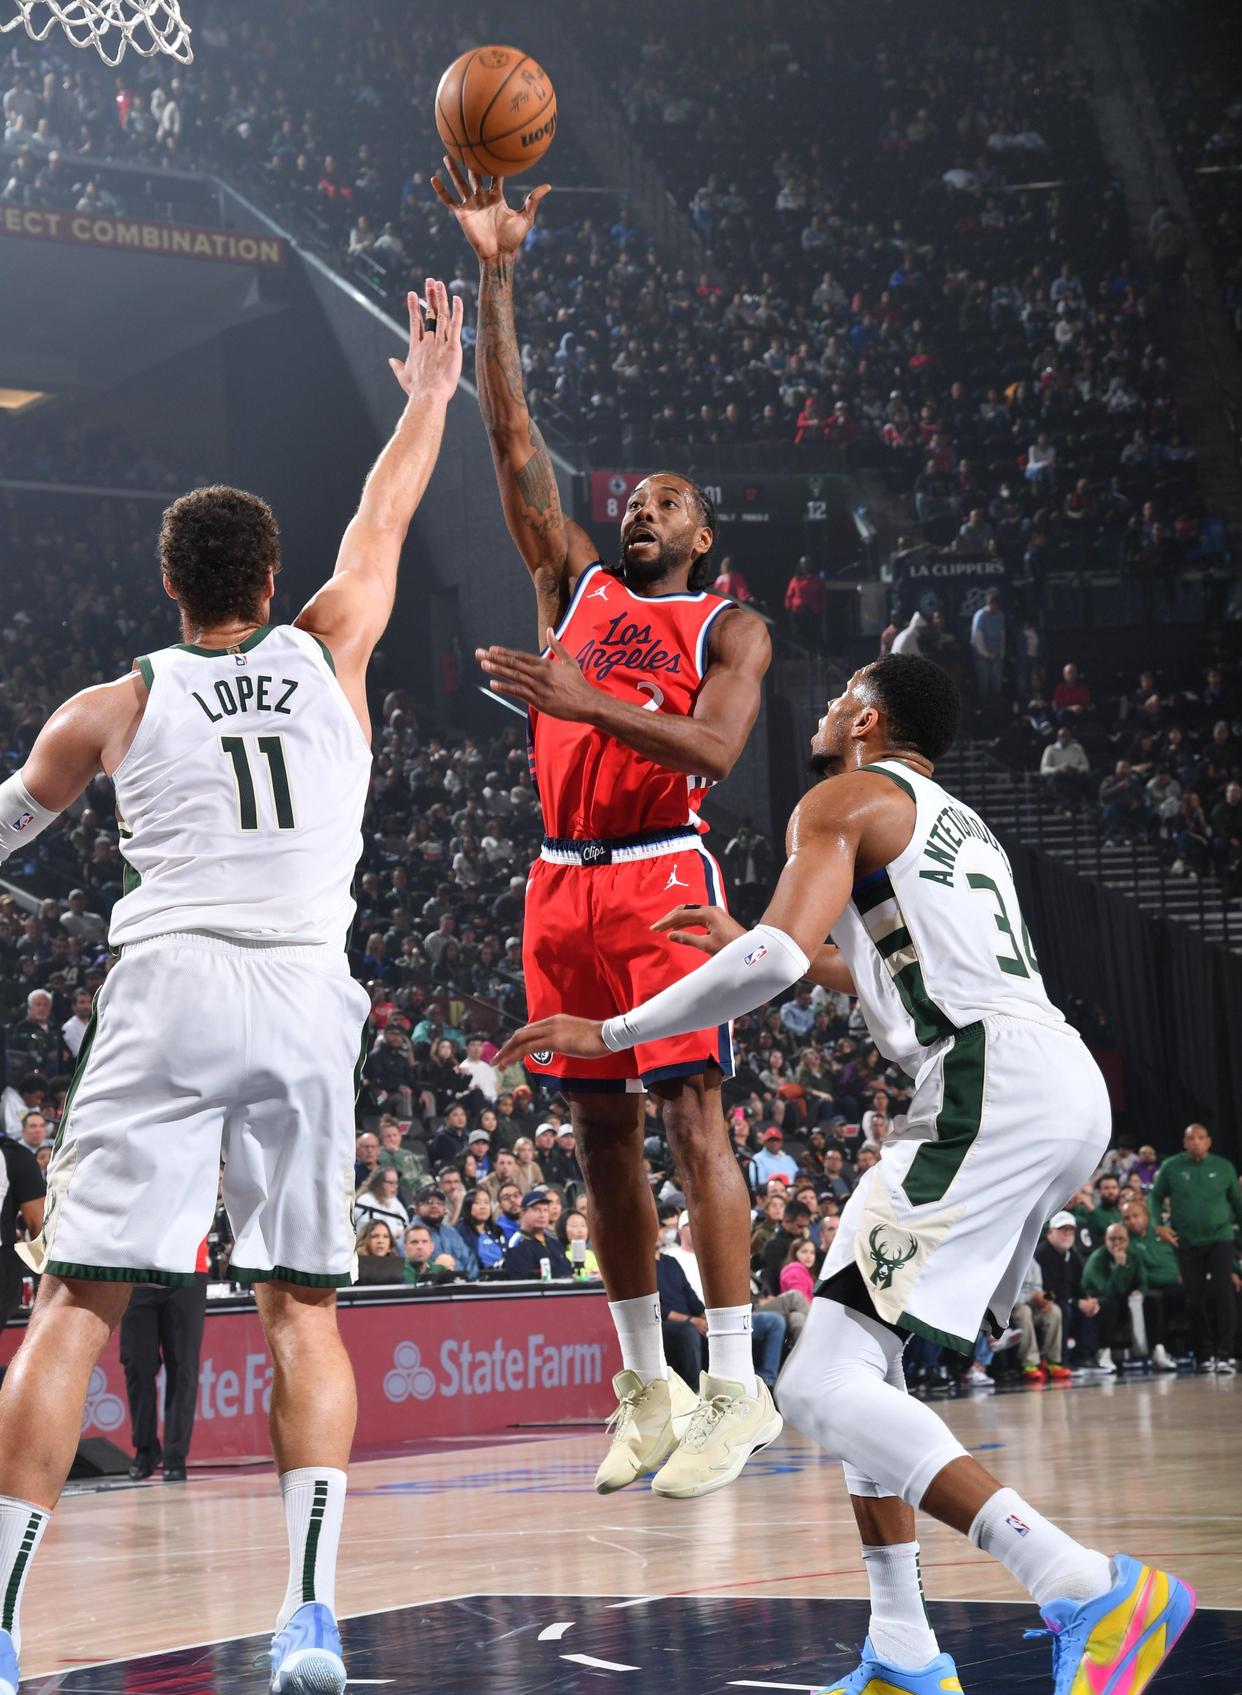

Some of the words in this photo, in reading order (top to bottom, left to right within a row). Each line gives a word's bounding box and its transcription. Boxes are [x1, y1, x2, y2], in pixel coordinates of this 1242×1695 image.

[0, 208, 60, 235] ECT
[72, 218, 280, 262] COMBINATION
[607, 498, 618, 517] 8
[807, 501, 827, 520] 12
[909, 564, 929, 577] LA
[932, 560, 1005, 577] CLIPPERS
[600, 611, 652, 646] Los
[576, 639, 682, 681] Angeles
[191, 675, 299, 724] LOPEZ
[218, 734, 298, 831] 11
[583, 845, 606, 861] Clips
